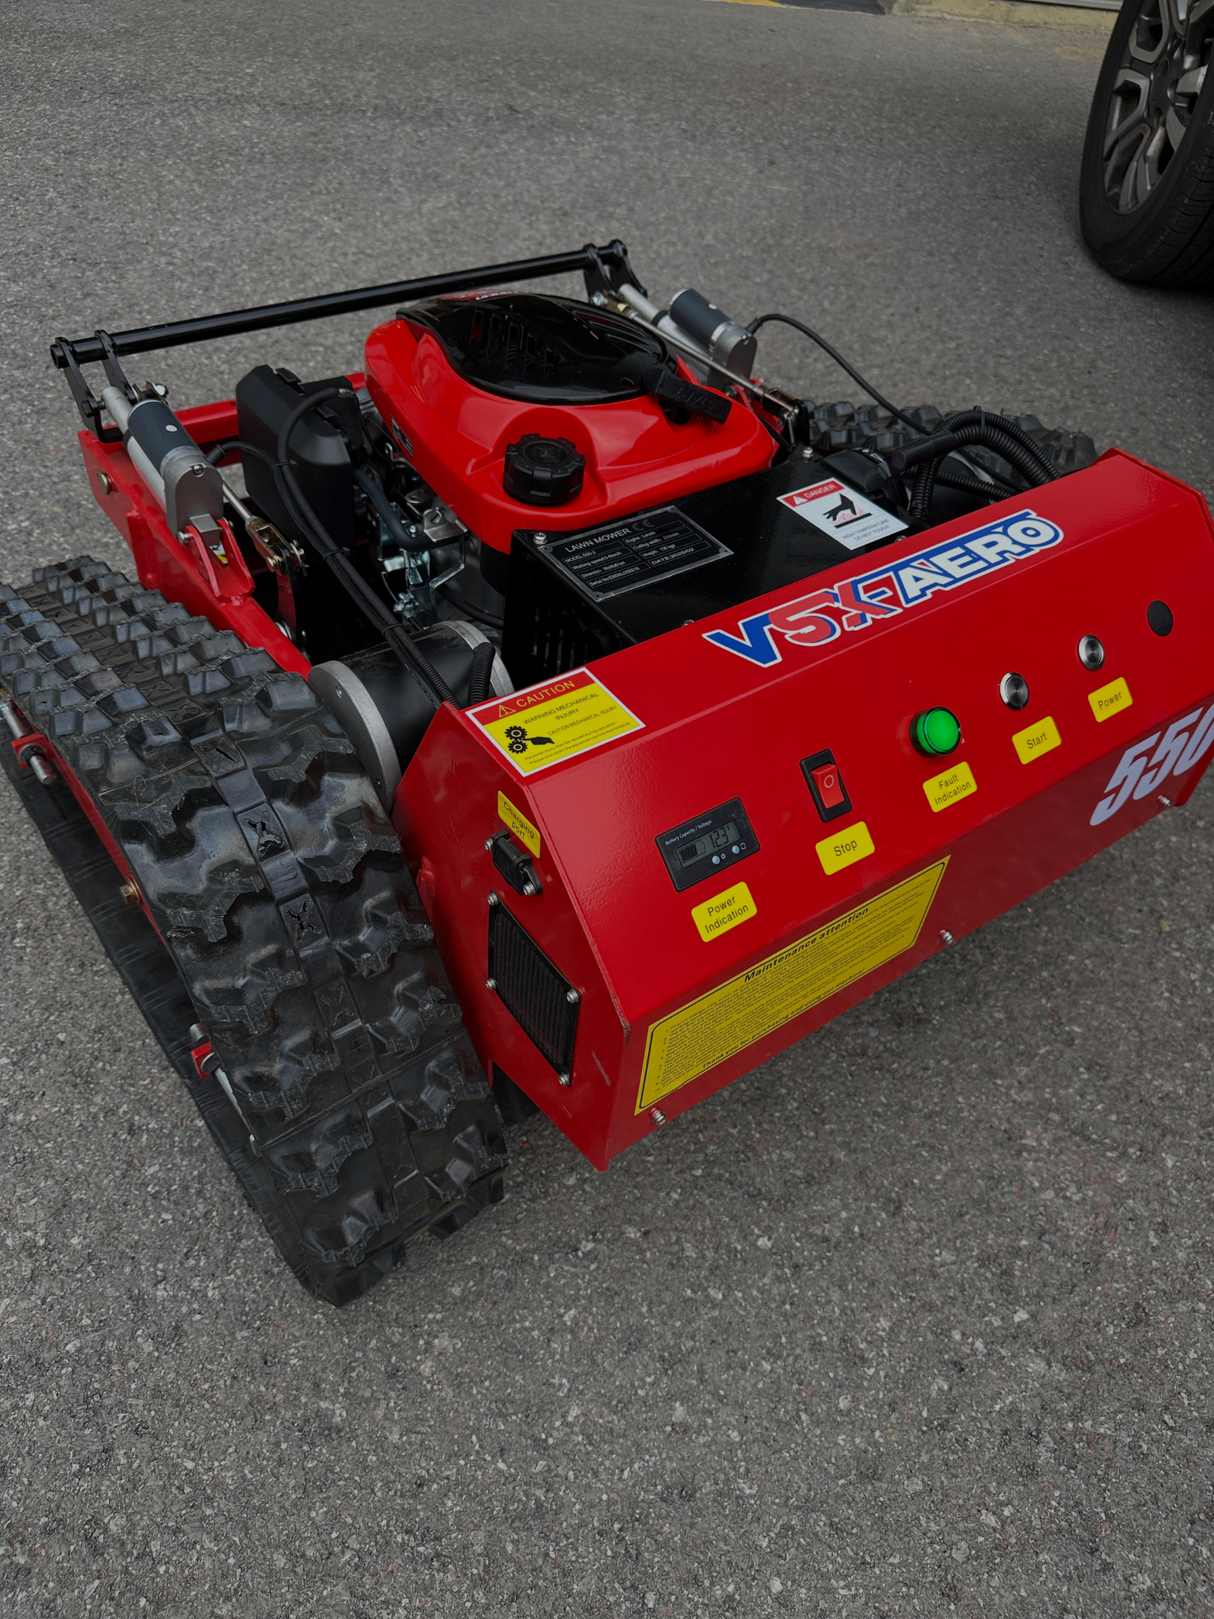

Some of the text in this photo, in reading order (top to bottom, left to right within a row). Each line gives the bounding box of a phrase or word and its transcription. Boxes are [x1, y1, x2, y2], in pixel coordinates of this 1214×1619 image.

[803, 483, 837, 499] DANGER
[842, 519, 890, 539] HIGH TEMPERATURE
[873, 525, 890, 534] TOUCH
[565, 539, 594, 553] LAWN
[593, 527, 632, 544] MOWER
[516, 680, 575, 707] CAUTION
[1097, 691, 1122, 710] Power
[523, 692, 600, 725] WARNING MECHANICAL
[554, 707, 580, 721] INJURY
[547, 705, 617, 736] CAUTION MECHANICAL INJURY
[1026, 732, 1048, 749] Start
[525, 752, 545, 761] Personal
[938, 774, 959, 790] Fault
[934, 781, 972, 806] Indication
[503, 801, 534, 840] Charging
[511, 821, 525, 839] port
[679, 827, 696, 840] Capacity
[698, 819, 712, 830] Voltage
[833, 839, 858, 857] Stop
[707, 896, 736, 916] Power
[704, 904, 749, 934] Indication
[744, 908, 869, 982] Maintenance attention
[702, 1053, 724, 1068] Thank
[751, 1014, 790, 1039] purchasing
